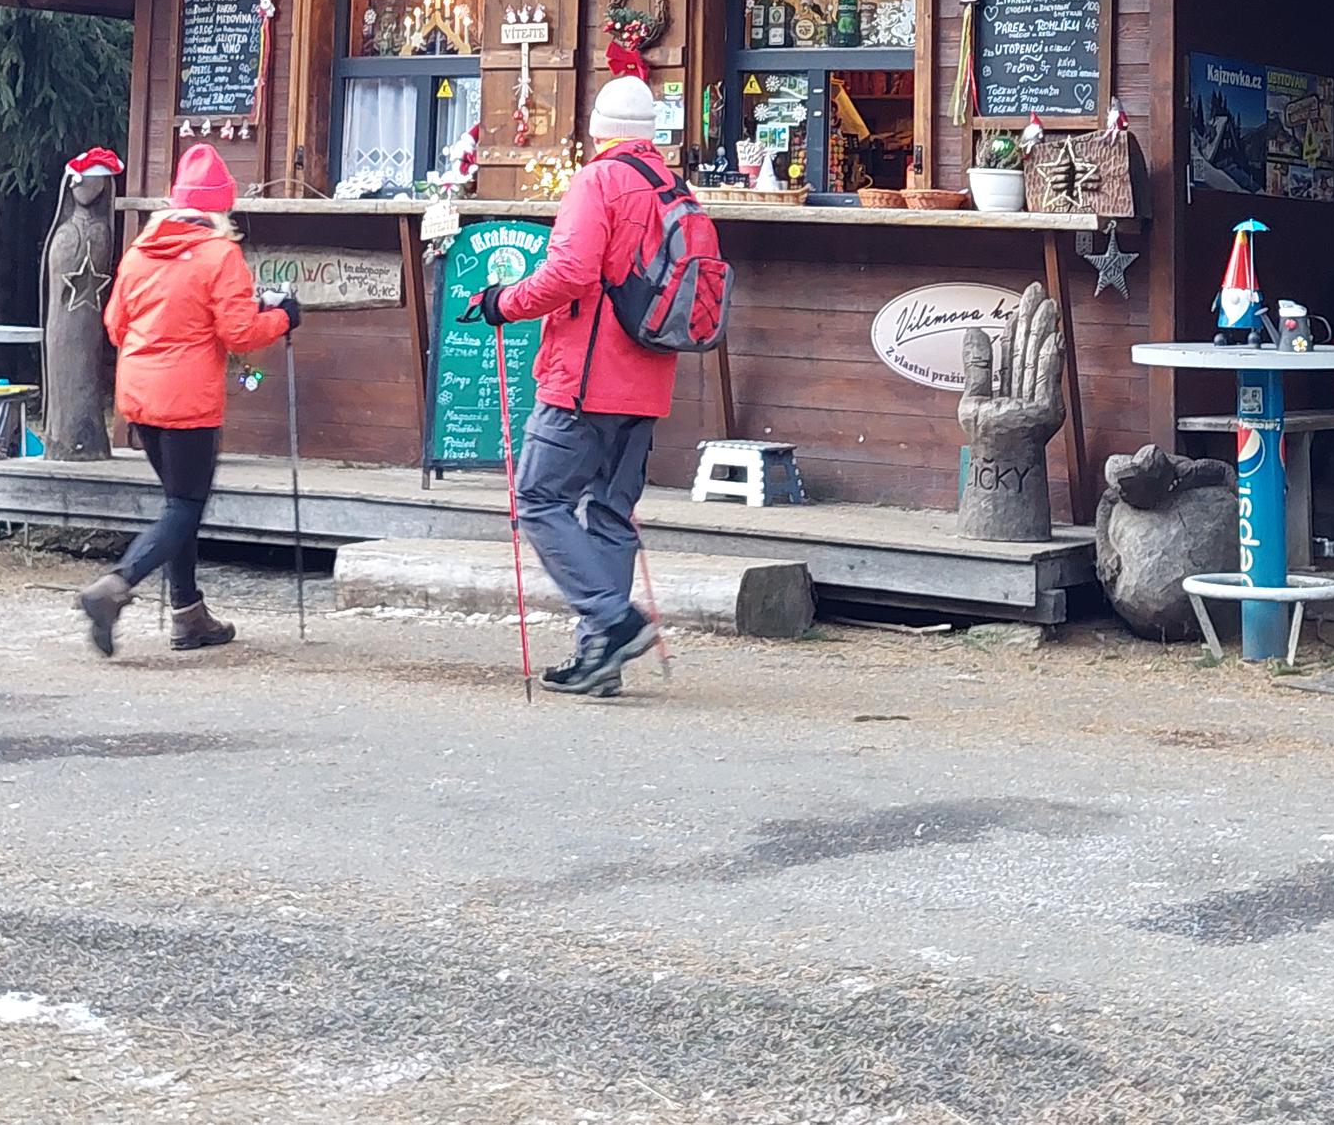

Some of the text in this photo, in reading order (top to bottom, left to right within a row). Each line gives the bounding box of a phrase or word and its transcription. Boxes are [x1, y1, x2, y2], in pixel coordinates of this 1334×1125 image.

[503, 26, 546, 40] VÍTEJTE
[1206, 63, 1263, 90] Kajzrovka.cz
[895, 299, 985, 343] Vilémova
[893, 356, 931, 378] vlastní
[931, 367, 967, 385] pražír
[968, 457, 1035, 494] IČKY
